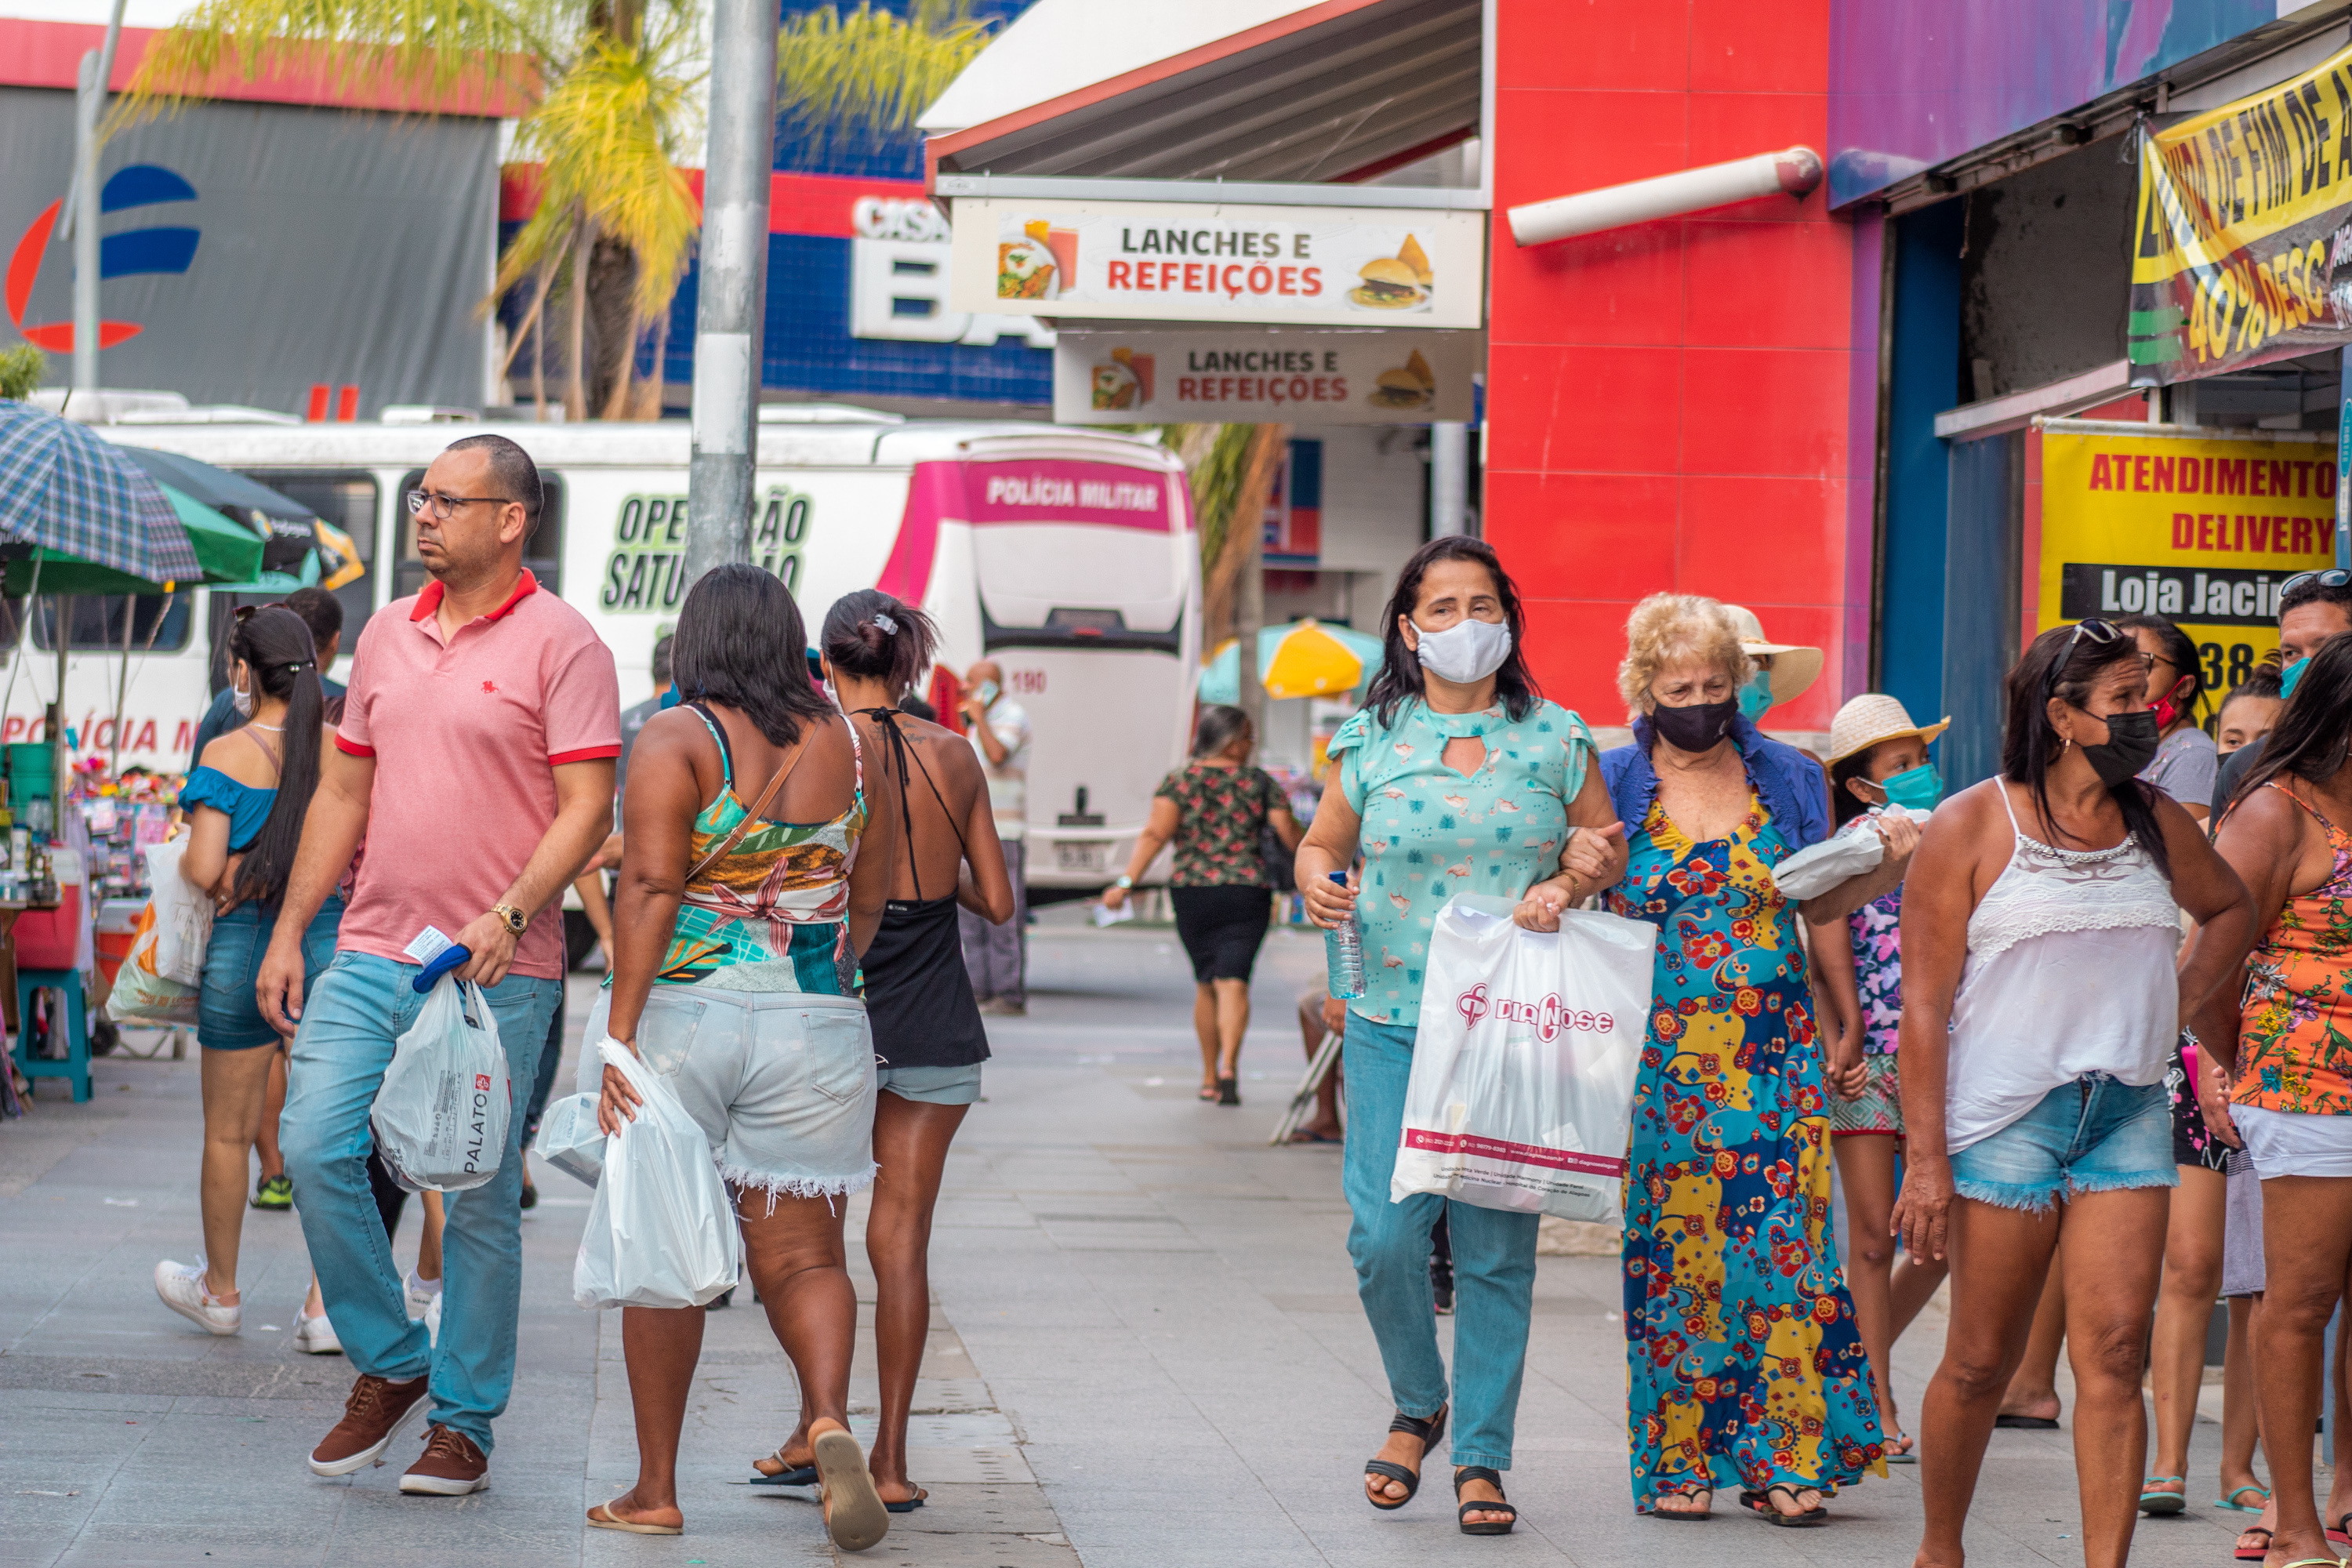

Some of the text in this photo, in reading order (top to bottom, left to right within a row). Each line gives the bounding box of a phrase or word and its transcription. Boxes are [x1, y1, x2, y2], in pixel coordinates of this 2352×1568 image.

[2284, 80, 2330, 197] DE
[1121, 227, 1312, 260] LANCHES E
[1107, 260, 1323, 300] REFEIÇÕES
[2189, 259, 2266, 364] 40%
[2256, 239, 2326, 338] DESC
[1187, 351, 1338, 372] LANCHES E
[1178, 375, 1348, 406] REFEIÇÕES
[985, 472, 1160, 512] POLÍCIA MILITAR
[2089, 453, 2337, 500] ATENDIMENTO
[2171, 513, 2336, 555] DELIVERY
[2101, 569, 2183, 617] Loja
[463, 1093, 488, 1174] PALATO
